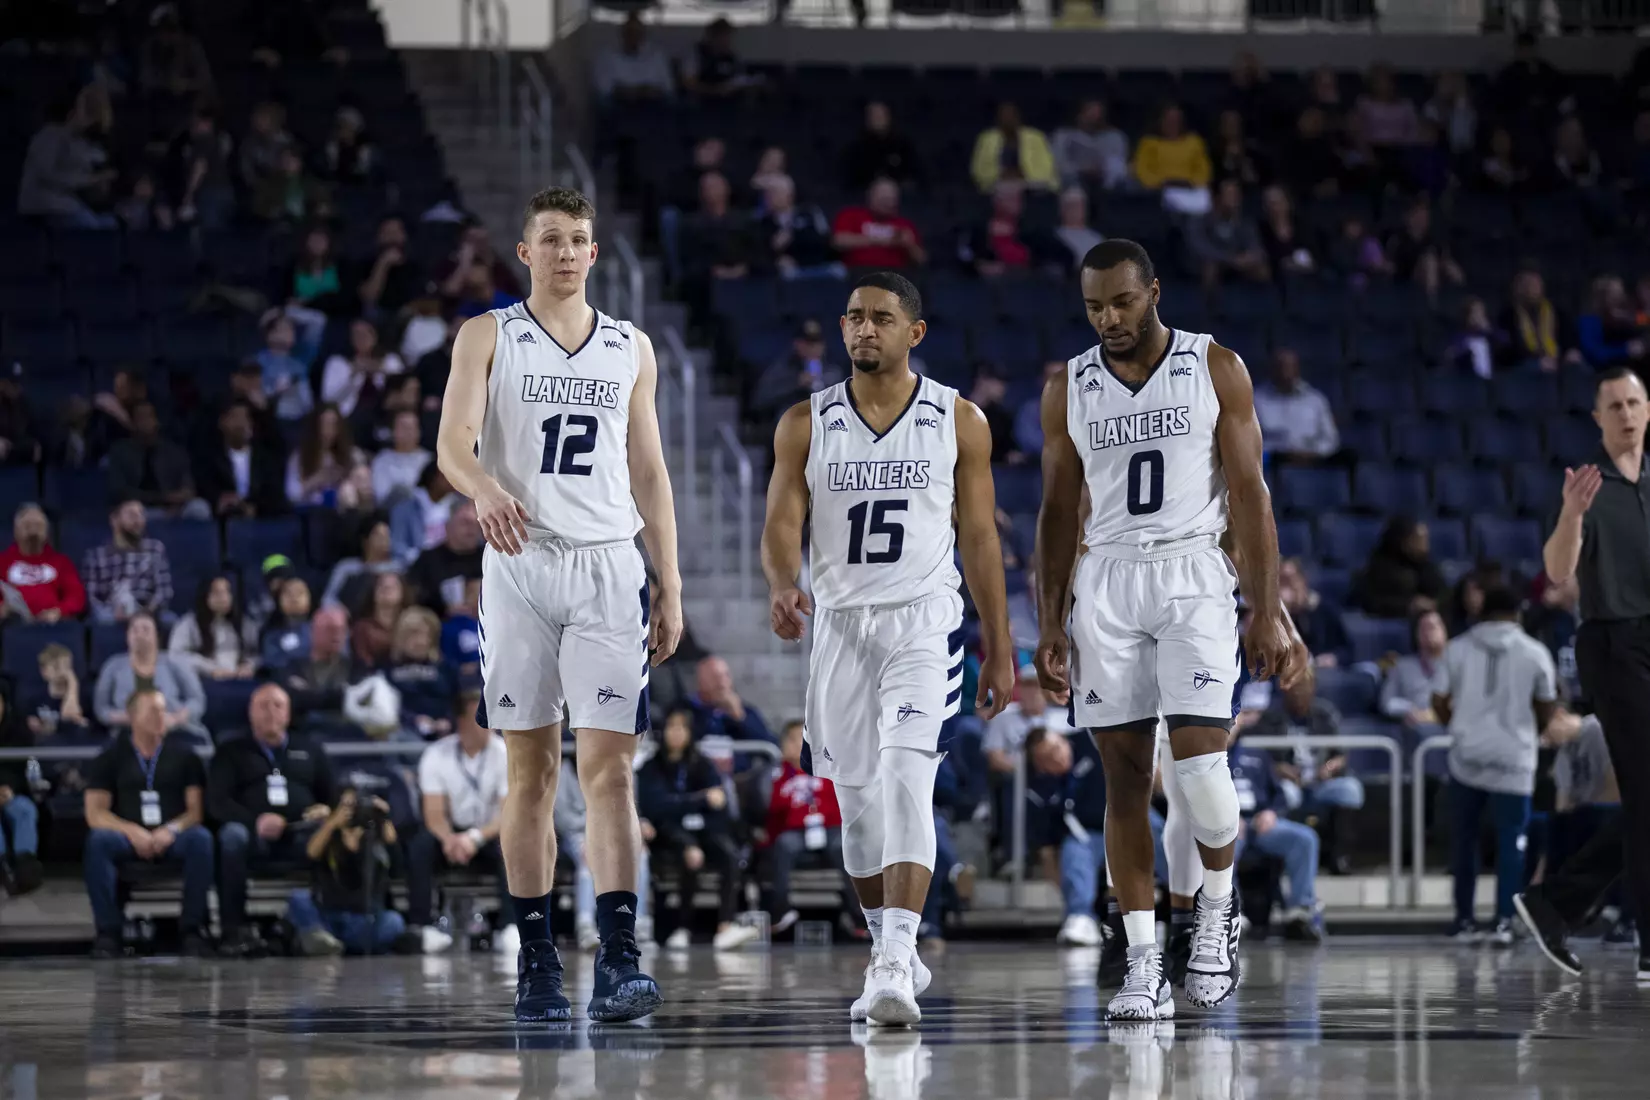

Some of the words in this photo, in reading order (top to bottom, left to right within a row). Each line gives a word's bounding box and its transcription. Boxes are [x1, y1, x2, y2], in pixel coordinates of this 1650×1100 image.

[604, 340, 623, 350] WAC
[1170, 367, 1192, 377] WAC
[522, 375, 620, 409] LANCERS
[915, 418, 938, 429] WAC
[1088, 406, 1190, 450] LANCERS
[540, 413, 599, 476] 12
[828, 460, 930, 492] LANCERS
[1127, 449, 1164, 516] 0
[847, 499, 909, 565] 15
